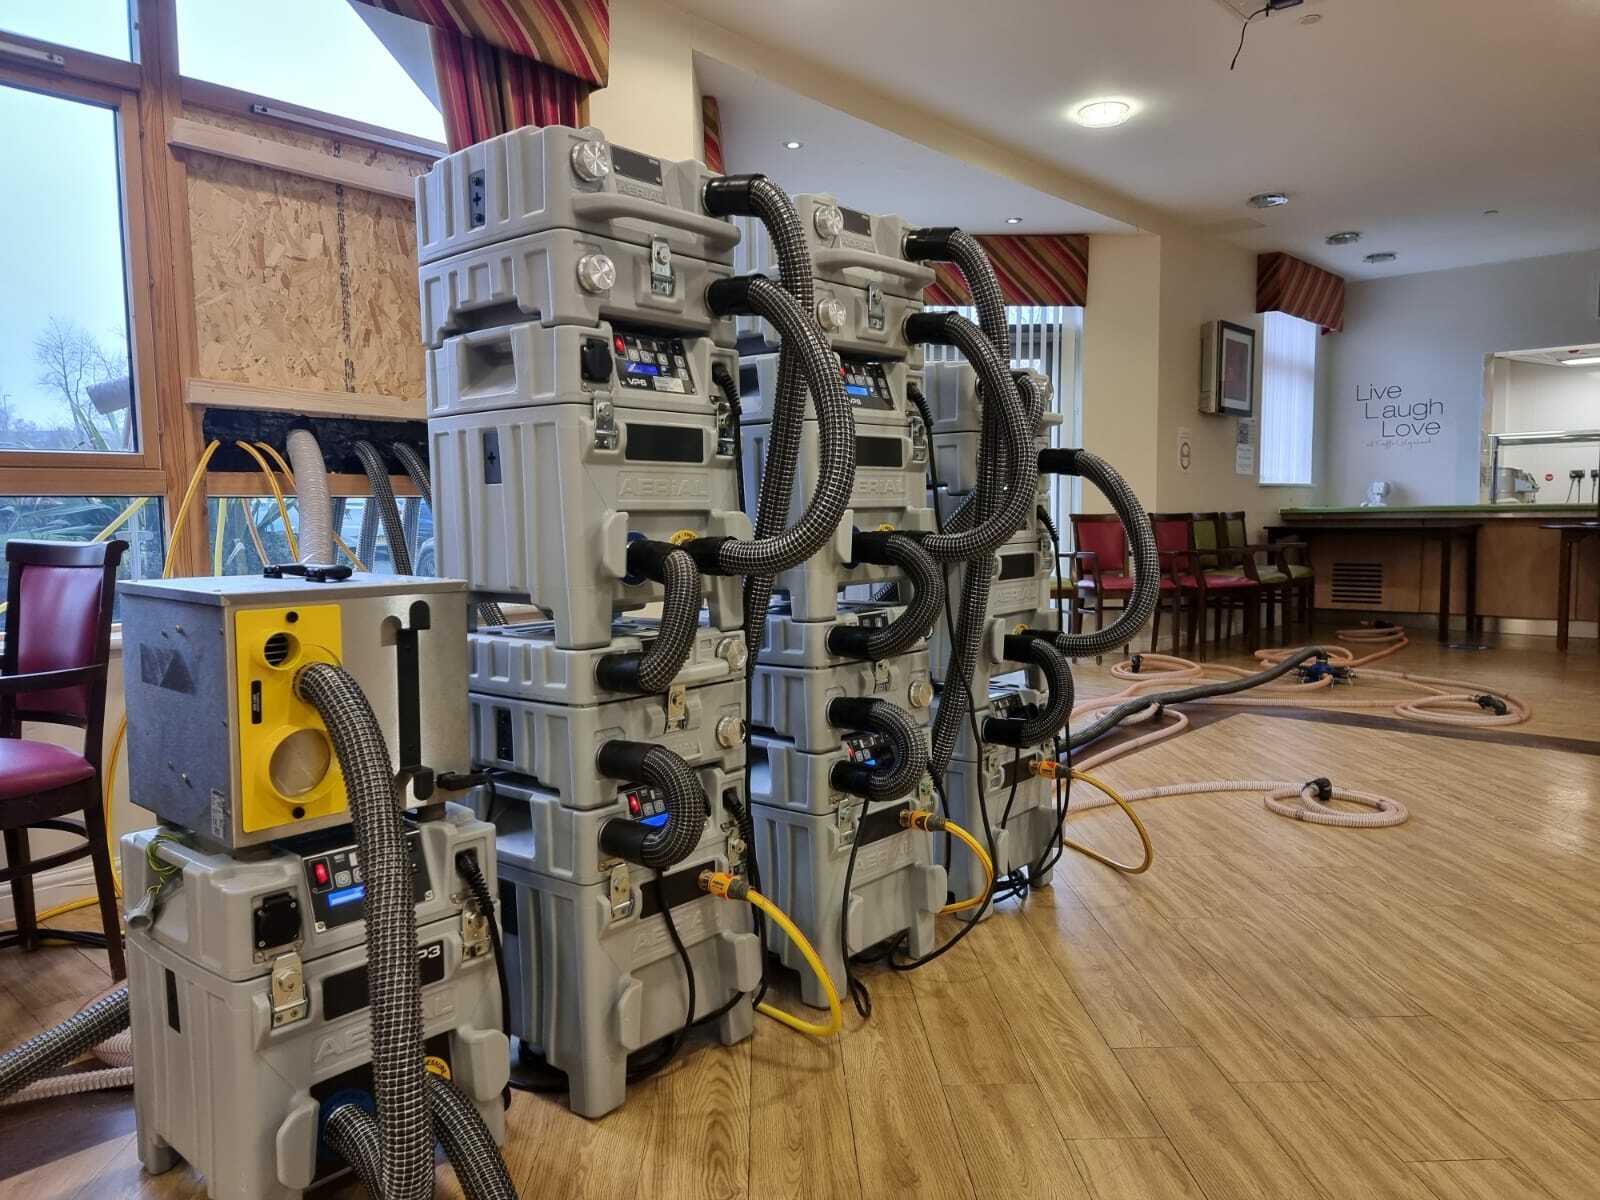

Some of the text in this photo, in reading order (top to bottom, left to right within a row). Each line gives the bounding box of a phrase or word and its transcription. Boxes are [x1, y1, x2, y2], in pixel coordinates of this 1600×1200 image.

[1356, 383, 1402, 402] Live
[1365, 398, 1444, 421] Laugh
[1381, 420, 1441, 438] Love
[856, 479, 905, 495] ERIAL
